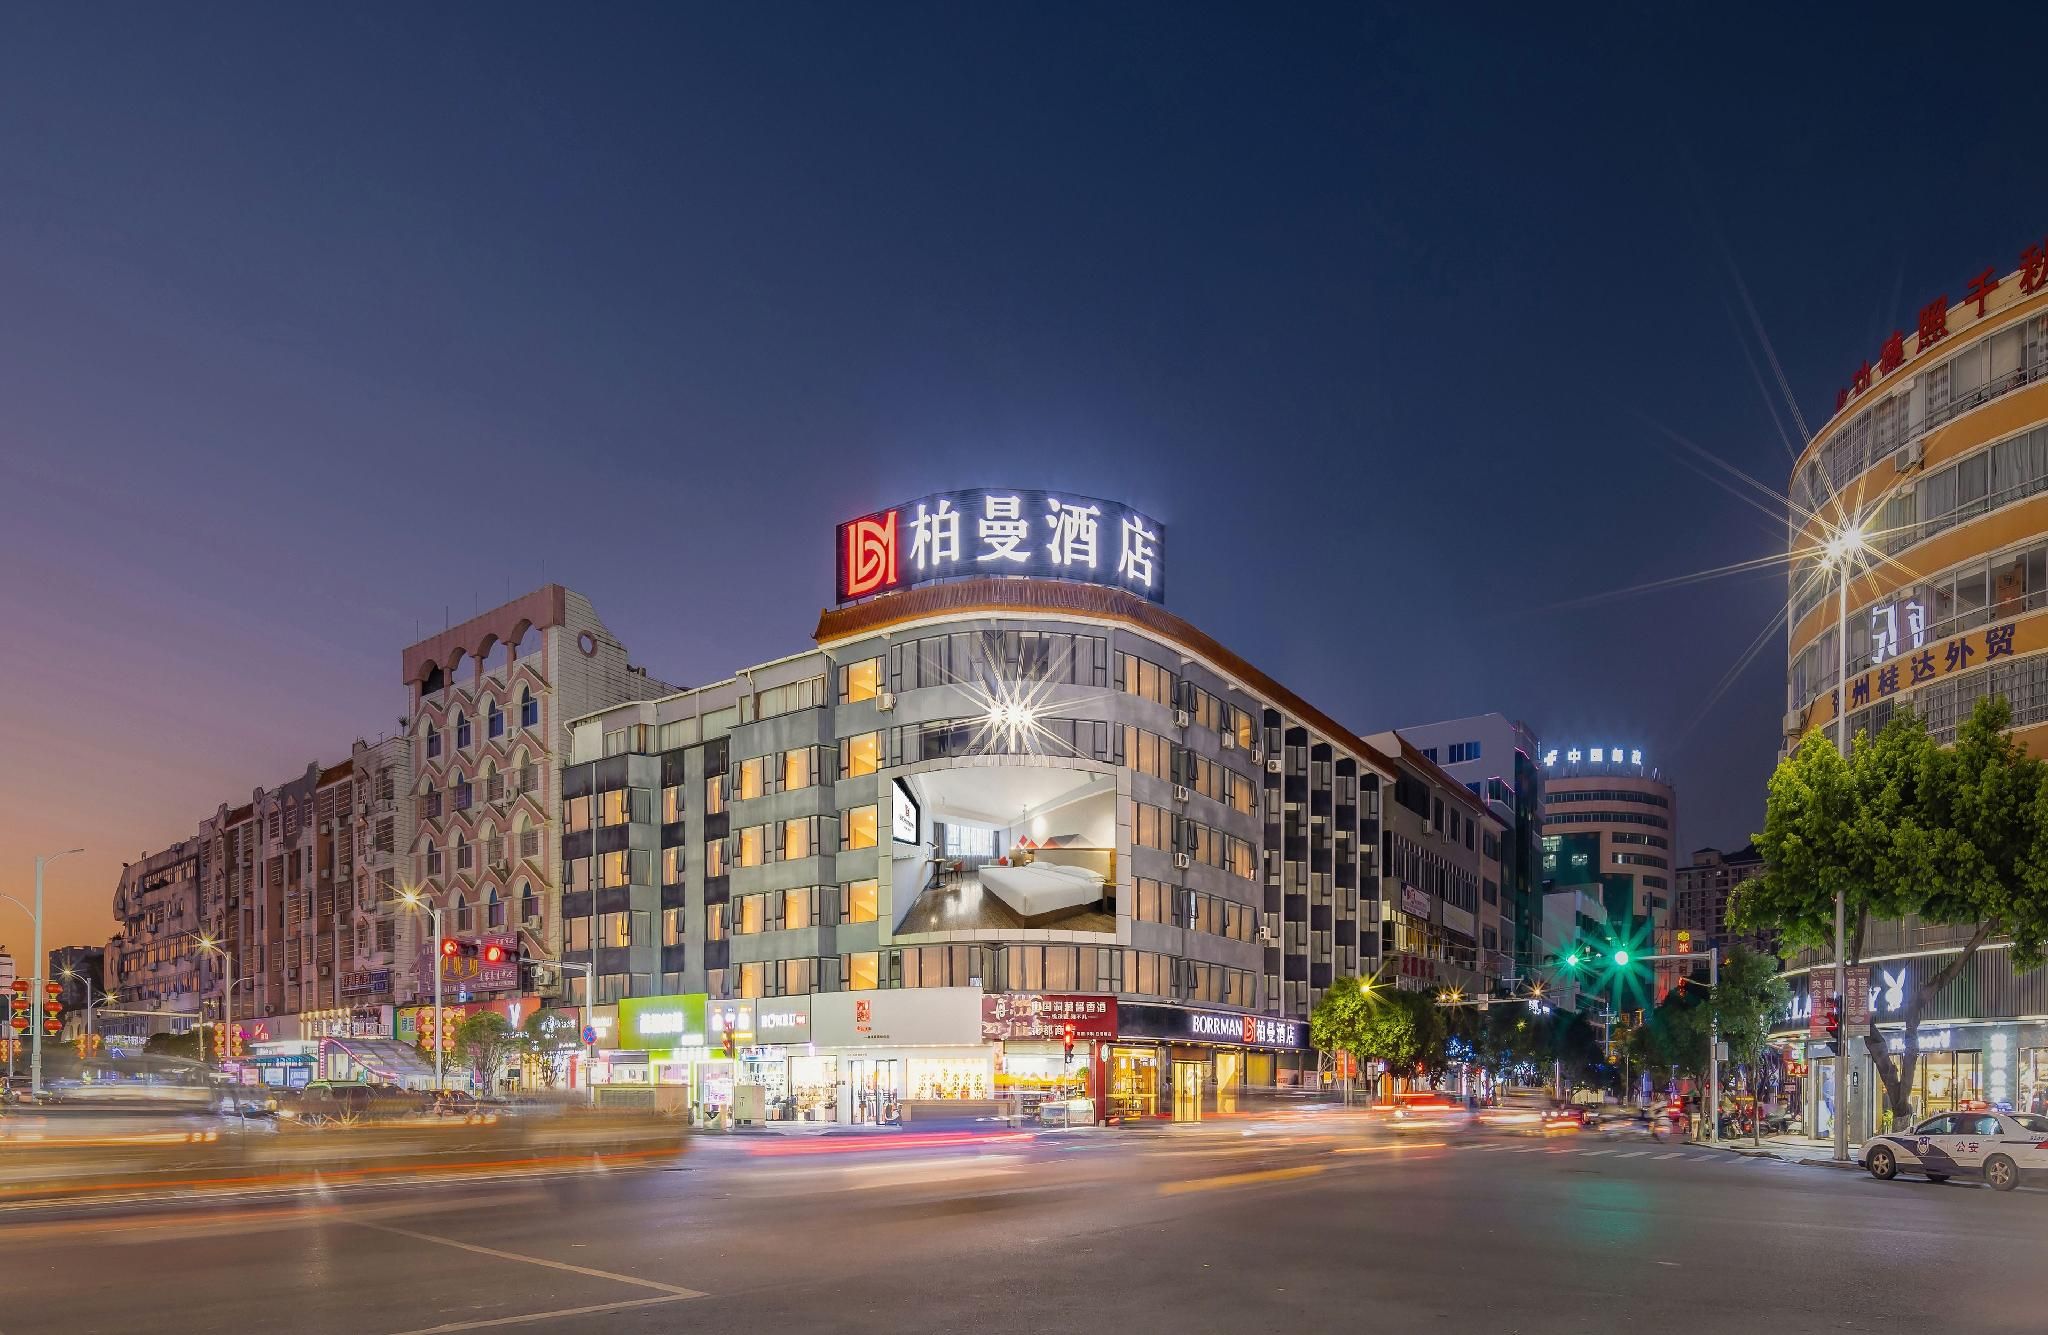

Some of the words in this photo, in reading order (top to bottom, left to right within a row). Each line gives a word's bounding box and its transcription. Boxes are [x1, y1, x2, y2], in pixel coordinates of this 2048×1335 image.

[909, 496, 1156, 587] 柏曼酒店
[1192, 1015, 1243, 1036] BORRMAN
[1257, 1019, 1295, 1045] 柏曼酒店
[1956, 1140, 1979, 1153] 公安
